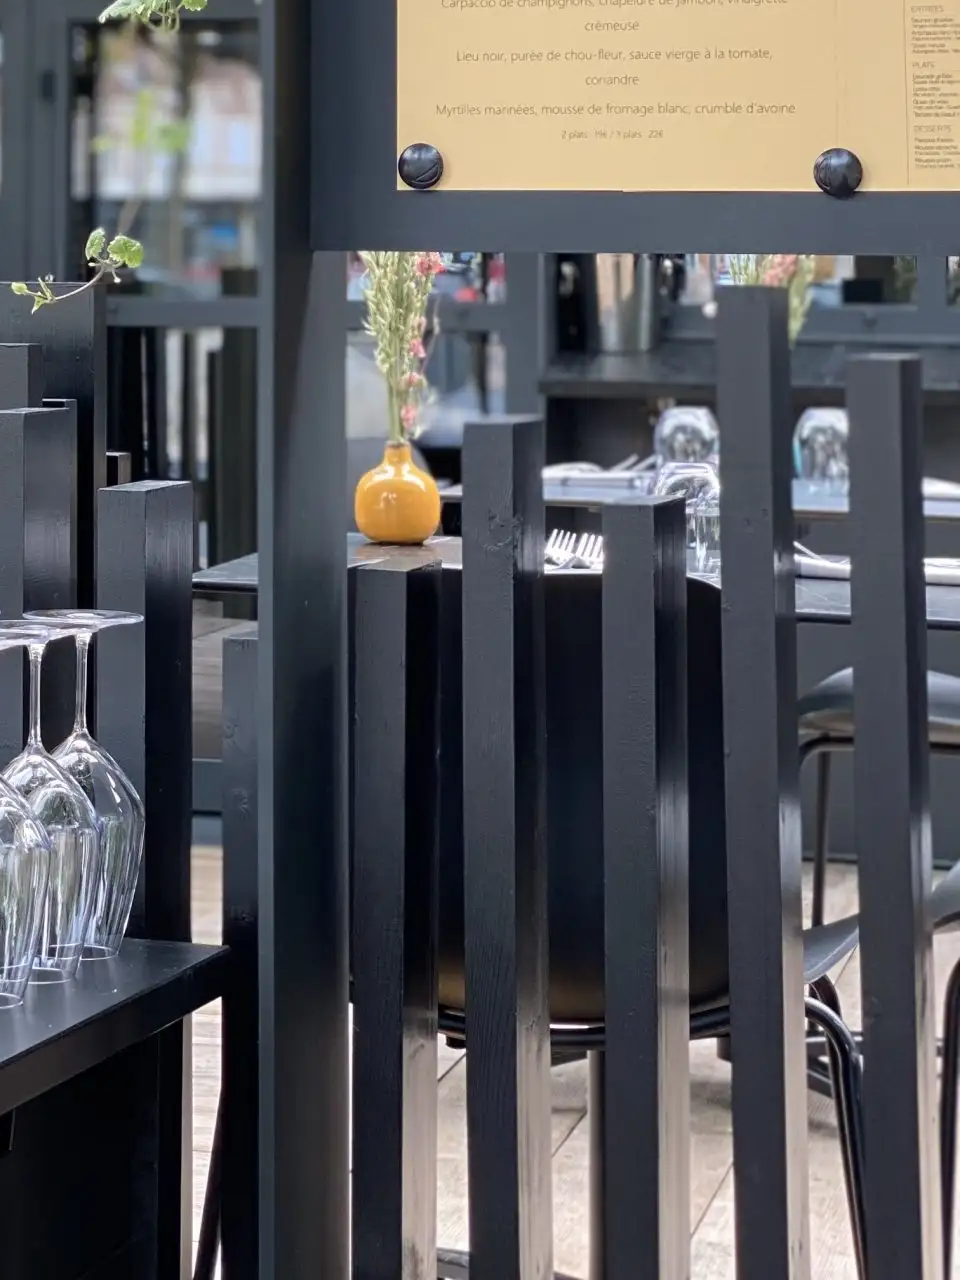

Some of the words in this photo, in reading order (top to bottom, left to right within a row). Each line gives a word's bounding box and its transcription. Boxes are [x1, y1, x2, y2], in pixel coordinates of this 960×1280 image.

[456, 49, 480, 63] Lieu
[482, 49, 507, 64] noir,
[510, 48, 543, 65] purée
[546, 48, 561, 62] de
[629, 49, 662, 61] sauce
[665, 46, 701, 63] vierge
[714, 46, 726, 60] la
[728, 46, 773, 62] tomate,
[585, 73, 639, 86] coriandre
[541, 104, 585, 116] mousse
[587, 102, 603, 115] de
[605, 102, 655, 118] fromage
[657, 101, 691, 116] blanc,
[694, 101, 744, 115] crumble
